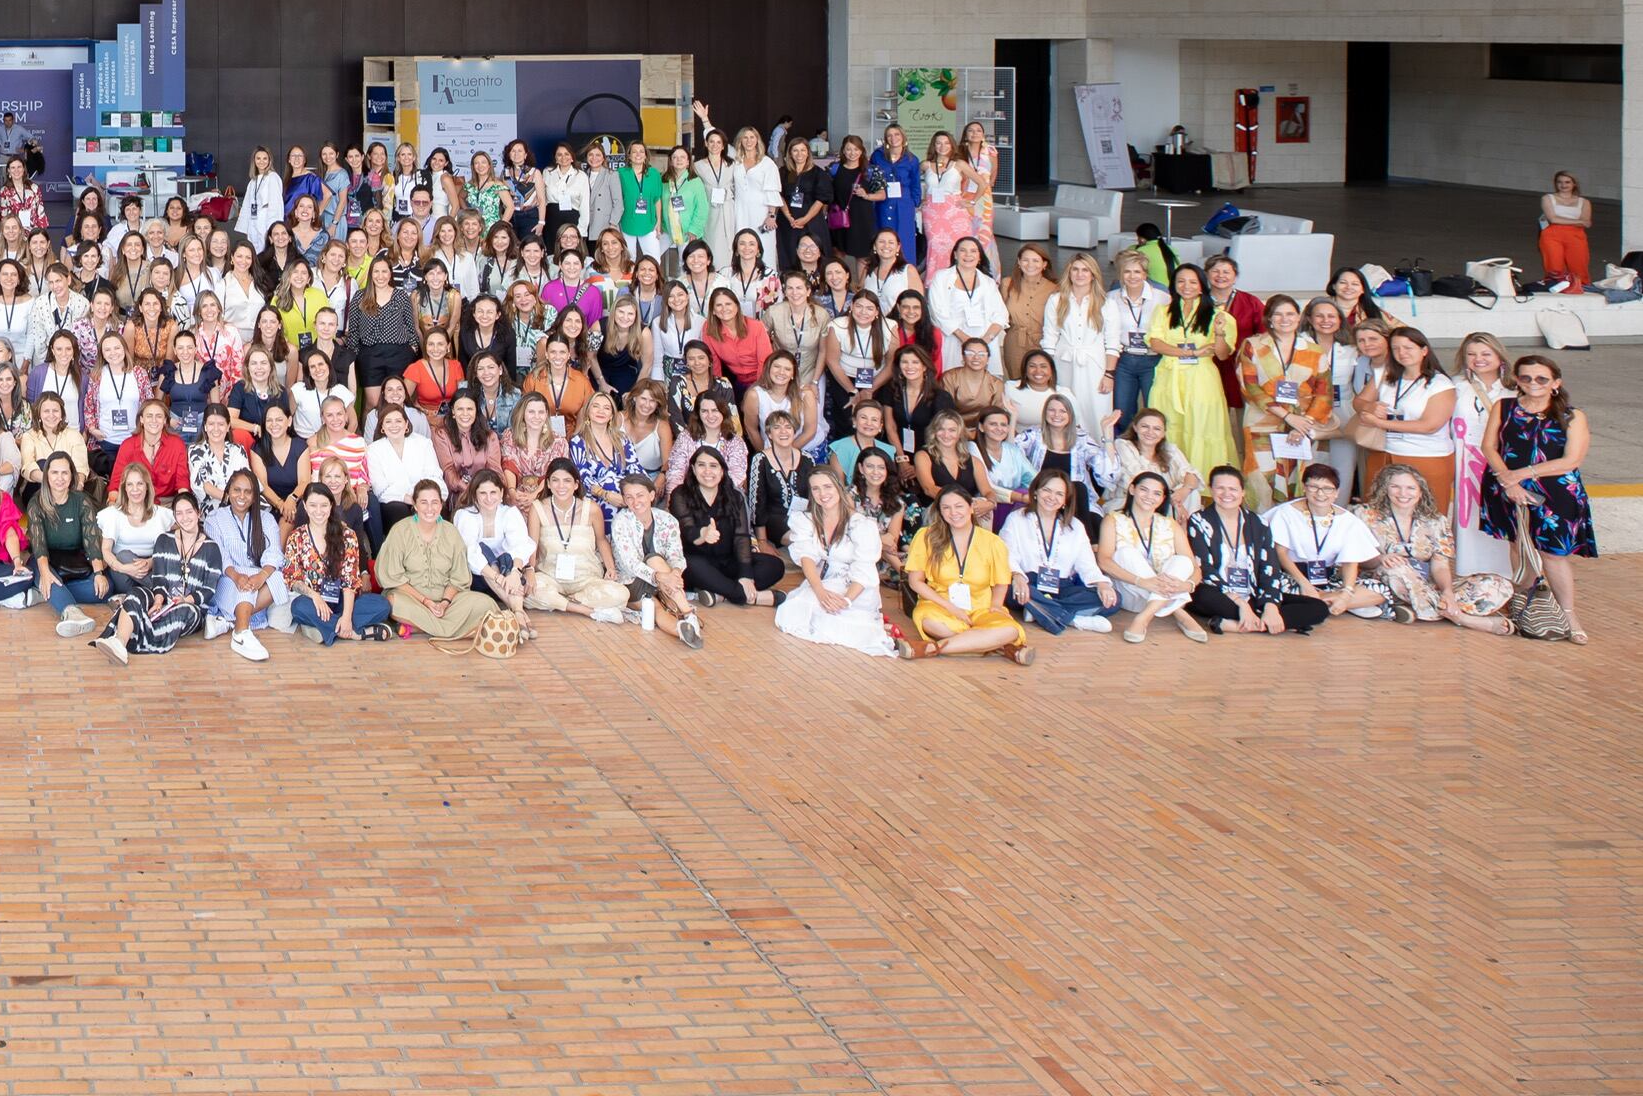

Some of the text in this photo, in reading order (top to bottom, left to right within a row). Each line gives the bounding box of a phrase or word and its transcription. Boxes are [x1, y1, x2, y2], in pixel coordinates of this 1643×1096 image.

[148, 11, 156, 75] Lifelong Learning
[433, 74, 503, 93] Encuentro
[439, 86, 480, 105] Anual
